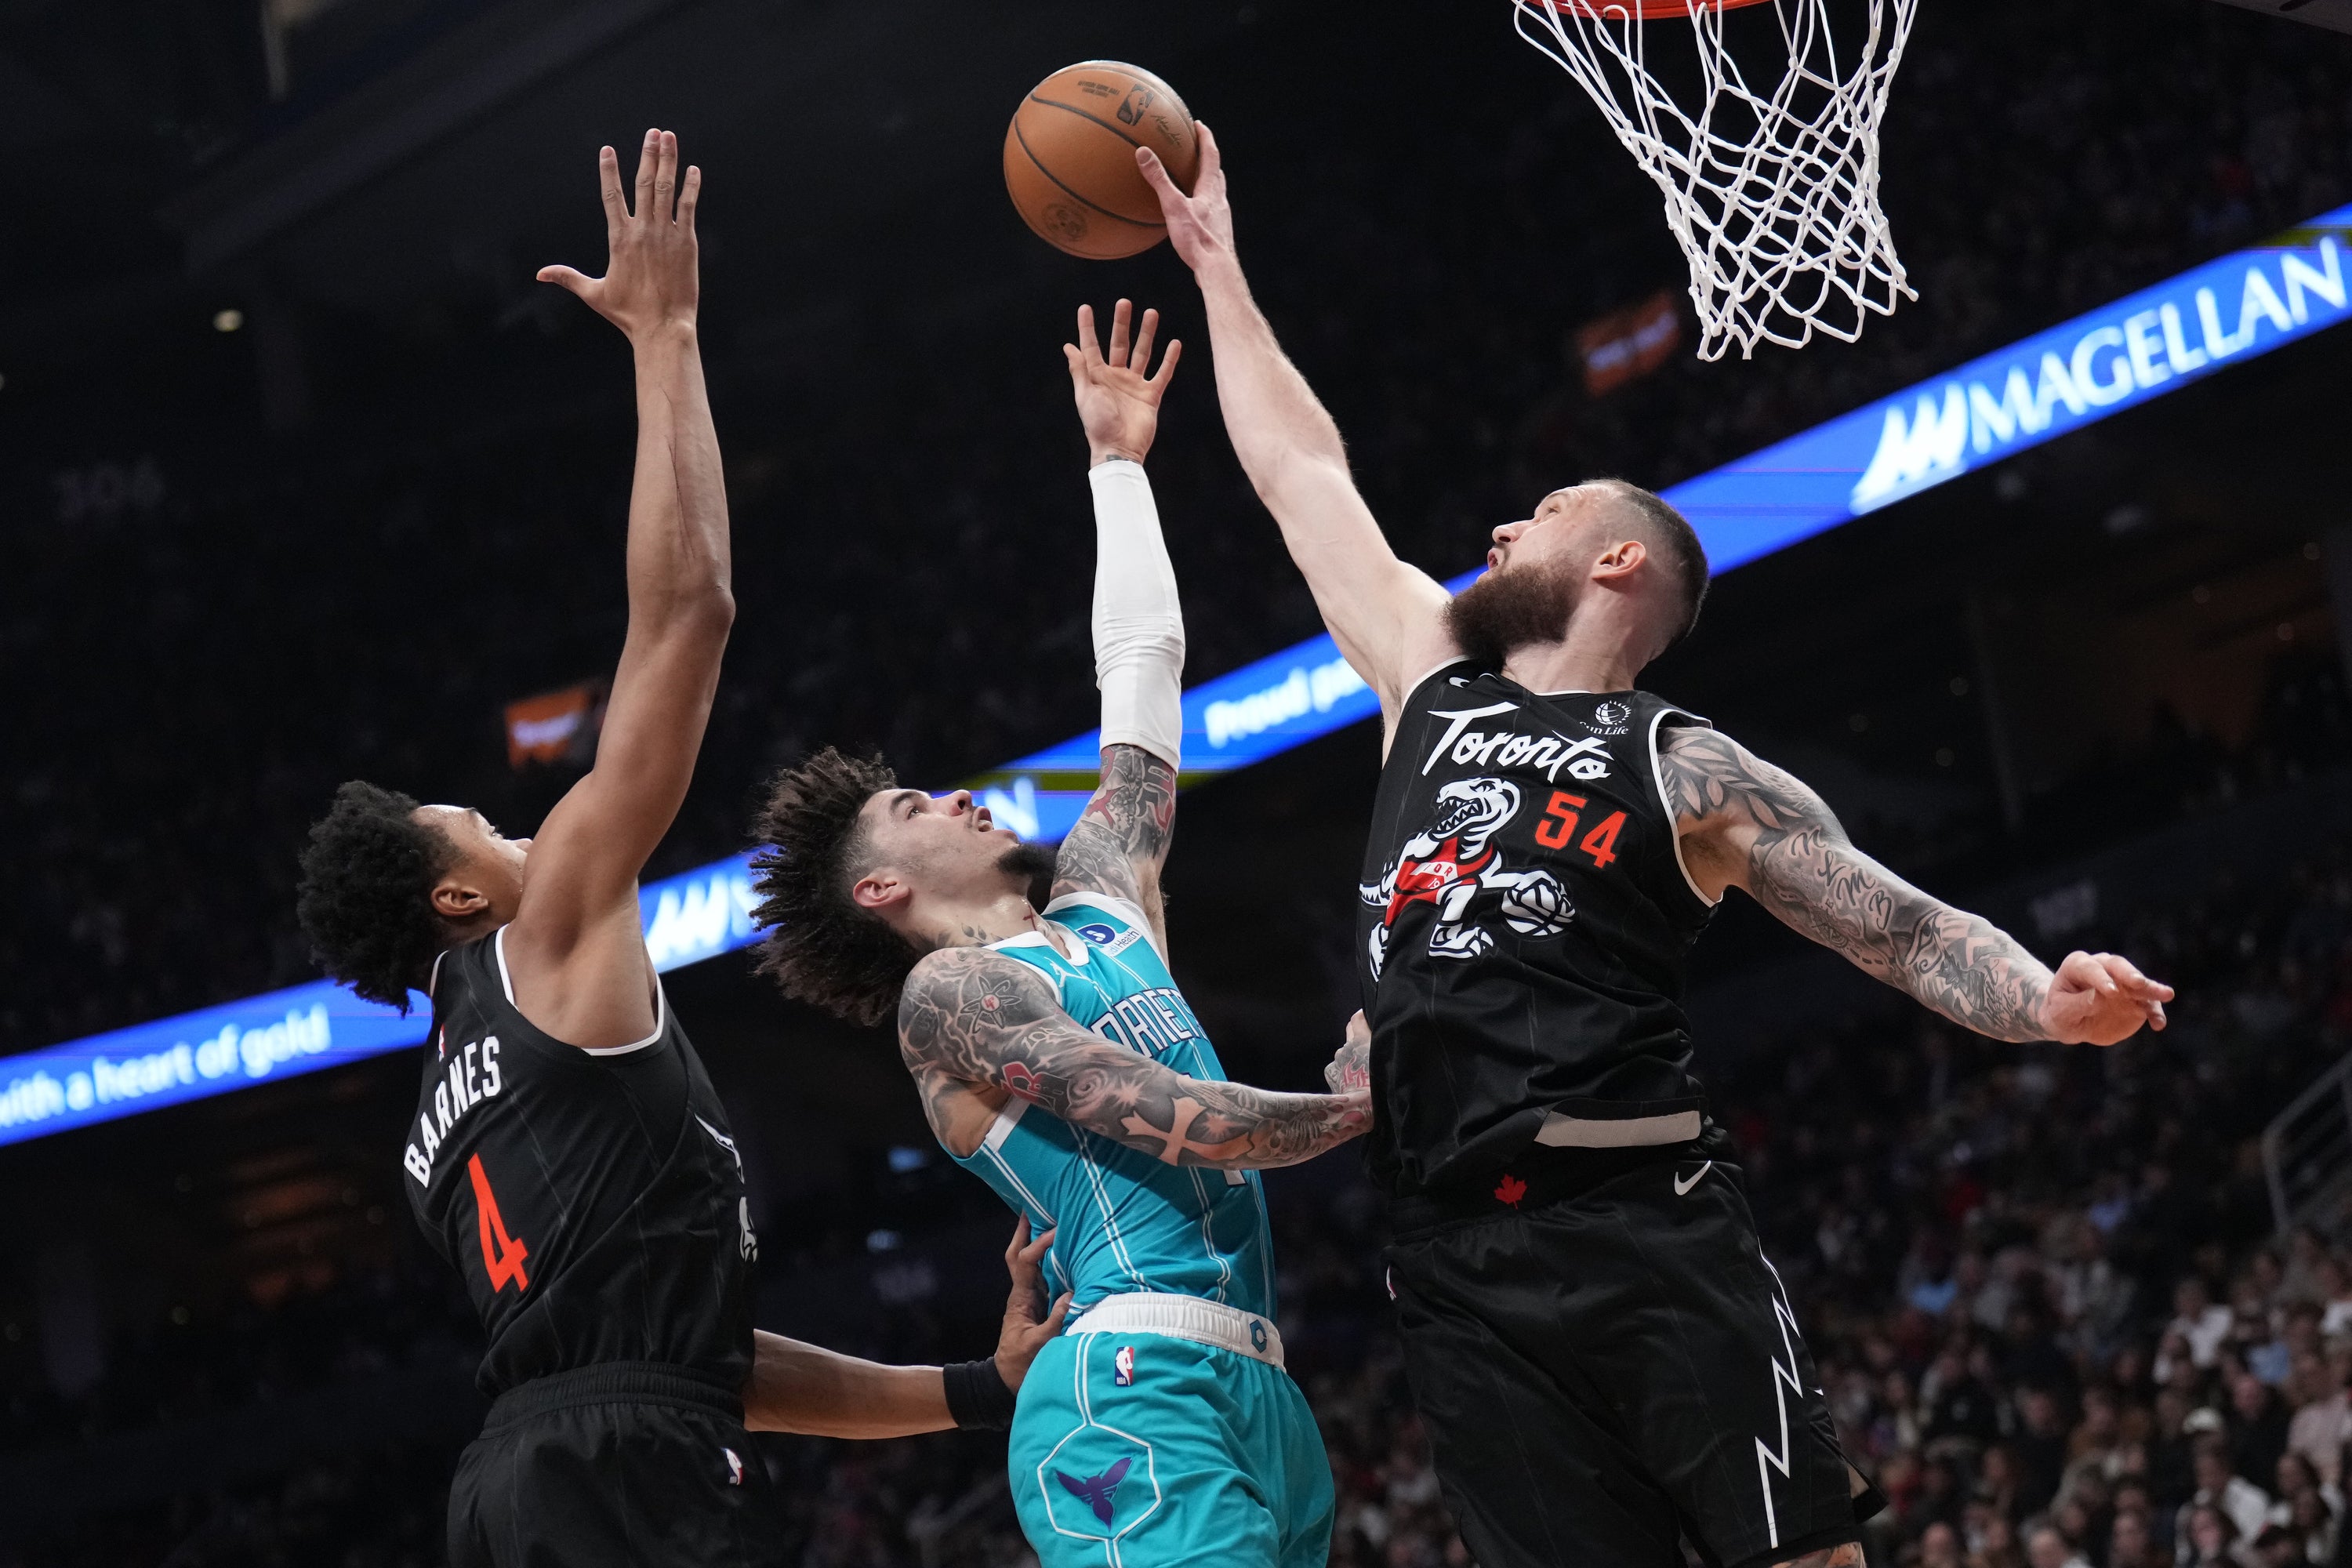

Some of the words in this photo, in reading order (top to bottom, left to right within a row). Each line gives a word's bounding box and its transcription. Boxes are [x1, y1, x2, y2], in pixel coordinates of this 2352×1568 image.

[1968, 237, 2348, 455] MAGELLAN
[1421, 701, 1615, 782] Toronto
[1603, 726, 1629, 735] Life
[1534, 791, 1632, 869] 54
[66, 1071, 93, 1111] a
[93, 1042, 195, 1105] heart
[195, 1022, 241, 1079] of
[240, 1001, 332, 1078] gold
[404, 1036, 502, 1188] BARNES
[467, 1152, 528, 1294] 4
